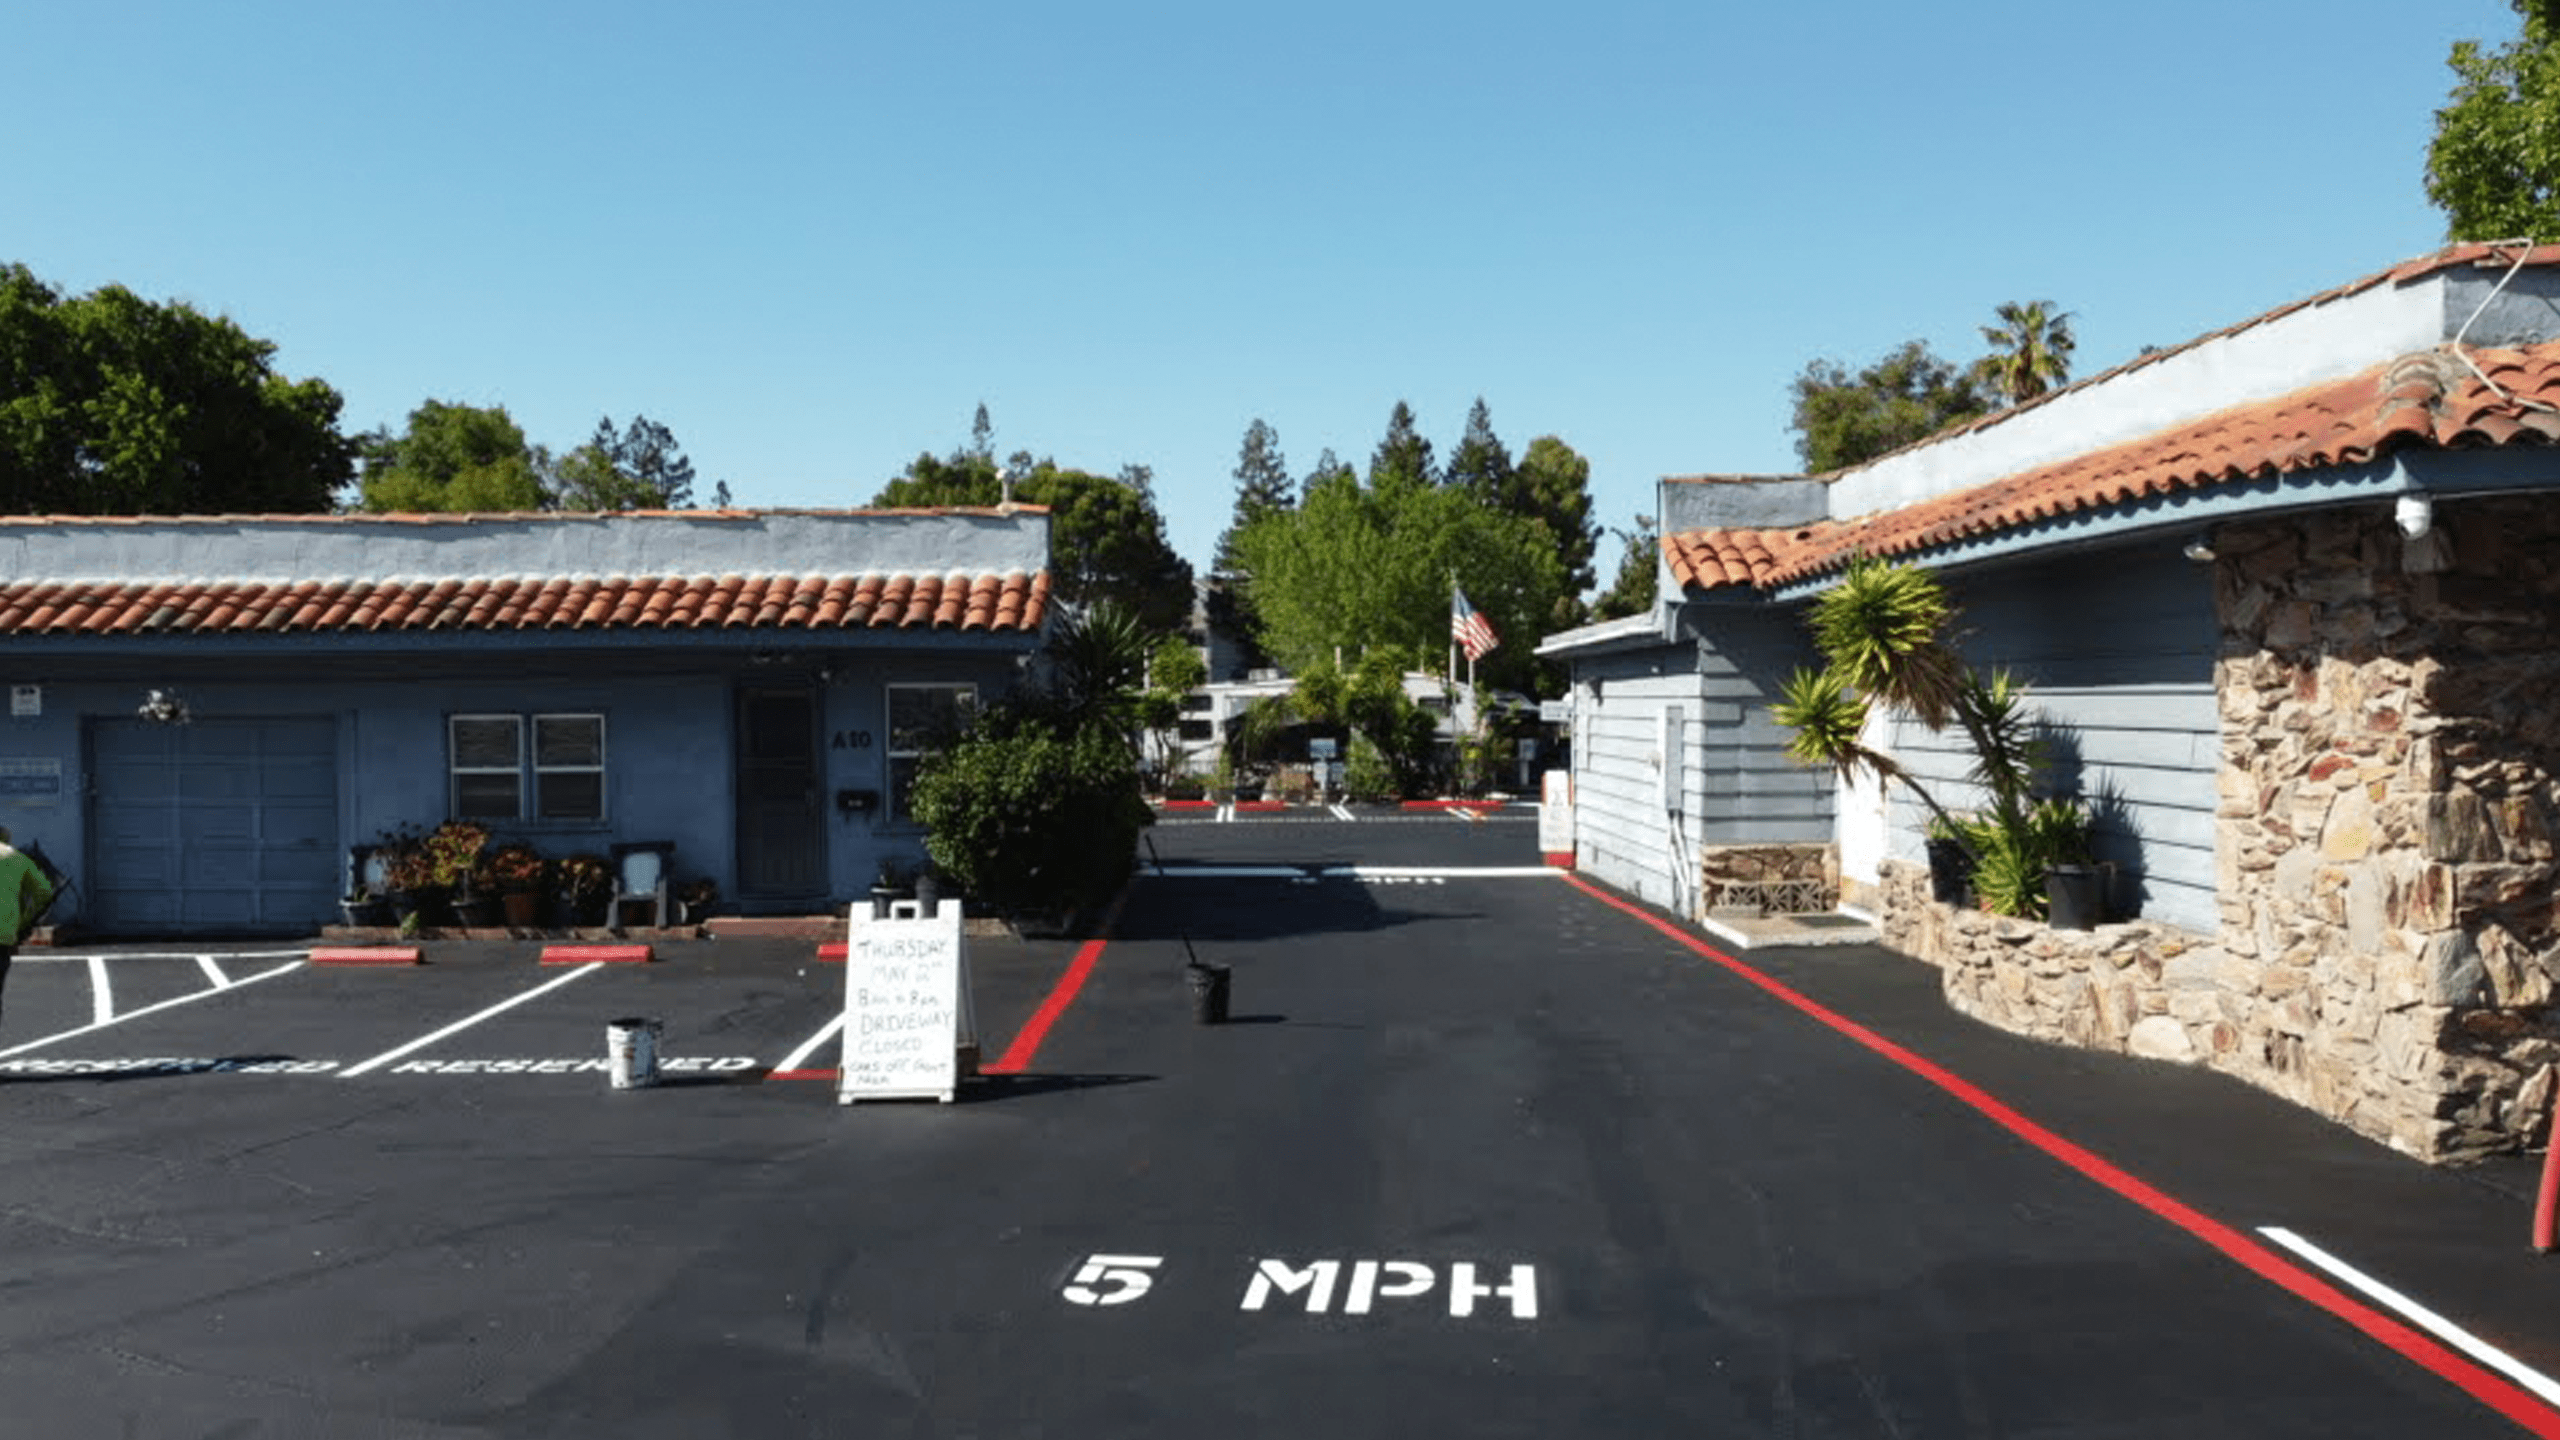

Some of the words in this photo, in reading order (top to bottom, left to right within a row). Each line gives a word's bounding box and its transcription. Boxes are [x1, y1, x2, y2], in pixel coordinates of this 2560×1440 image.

[857, 938, 948, 959] THURSDAY
[870, 964, 909, 984] MAY
[860, 1010, 953, 1036] DRIVEWAY
[1062, 1254, 1164, 1306] 5
[1240, 1259, 1538, 1319] MPH
